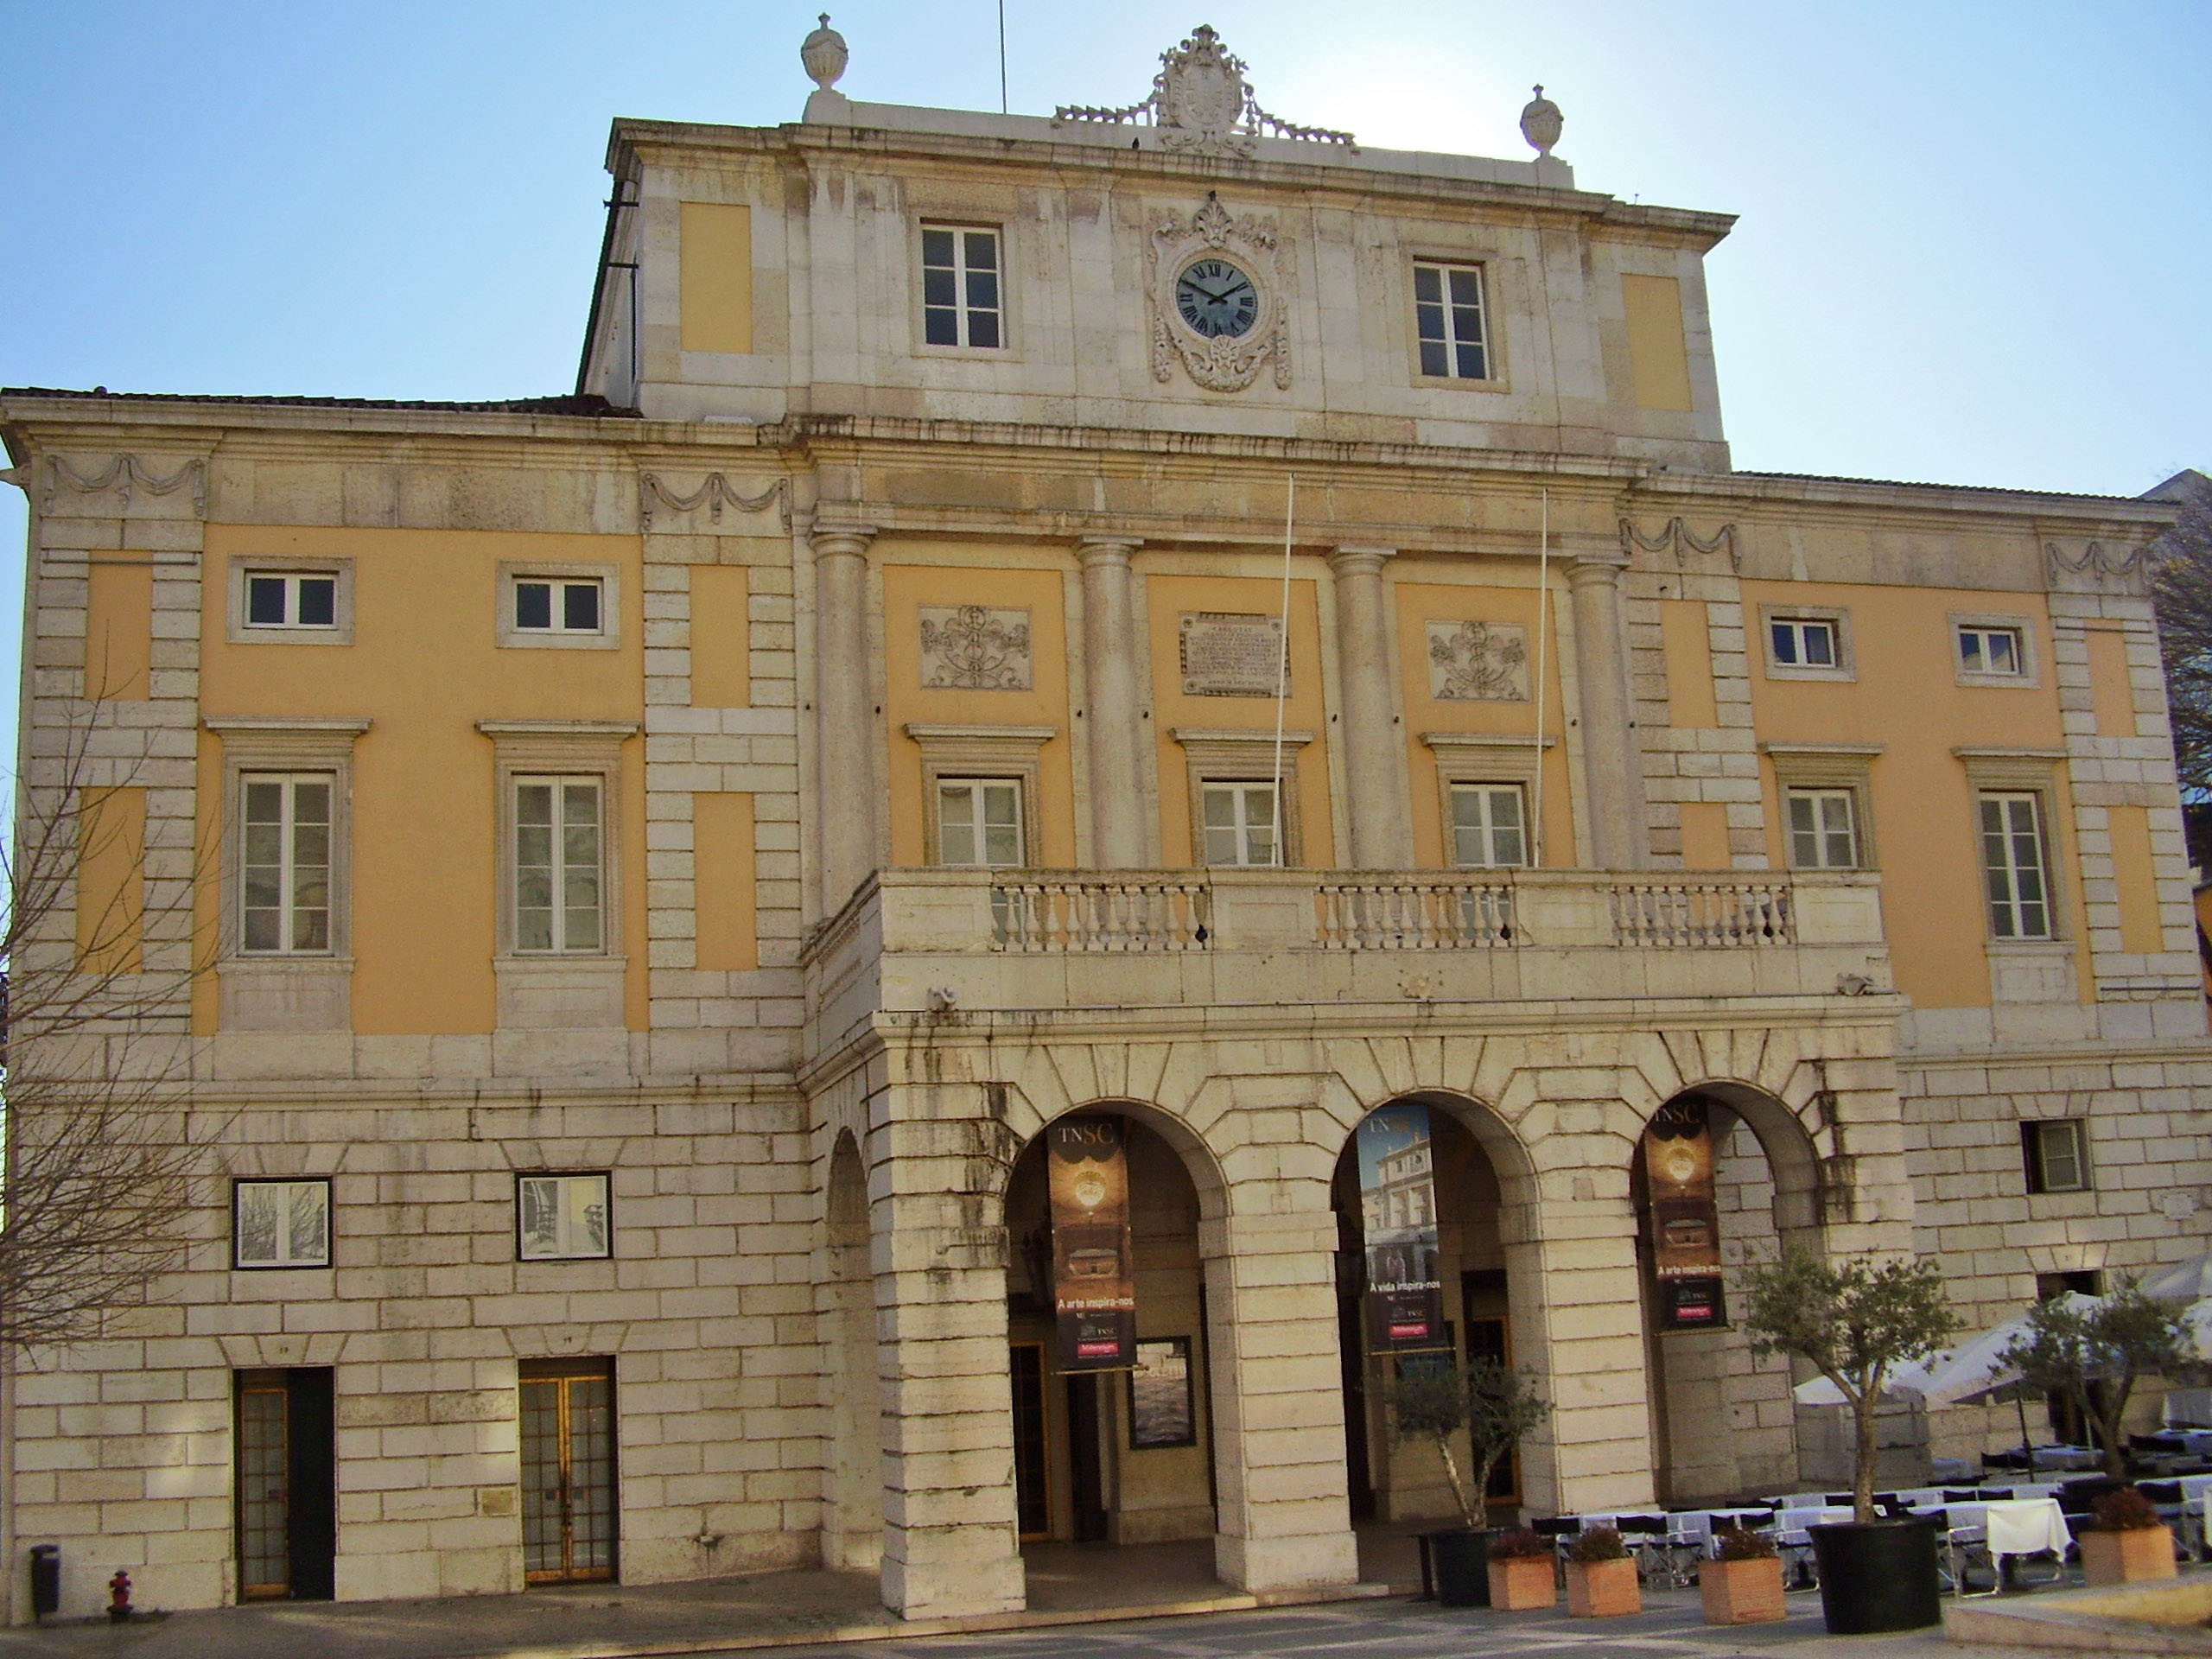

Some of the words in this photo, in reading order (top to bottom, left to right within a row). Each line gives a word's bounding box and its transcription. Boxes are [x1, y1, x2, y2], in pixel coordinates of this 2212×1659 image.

[1058, 1124, 1114, 1144] TNSC
[1658, 1266, 1665, 1275] A
[1370, 1282, 1376, 1293] A
[1377, 1282, 1395, 1292] vida
[1396, 1281, 1441, 1292] inspira-nos
[1058, 1299, 1065, 1309] A
[1066, 1299, 1085, 1308] arte
[1086, 1296, 1135, 1309] inspira-nos
